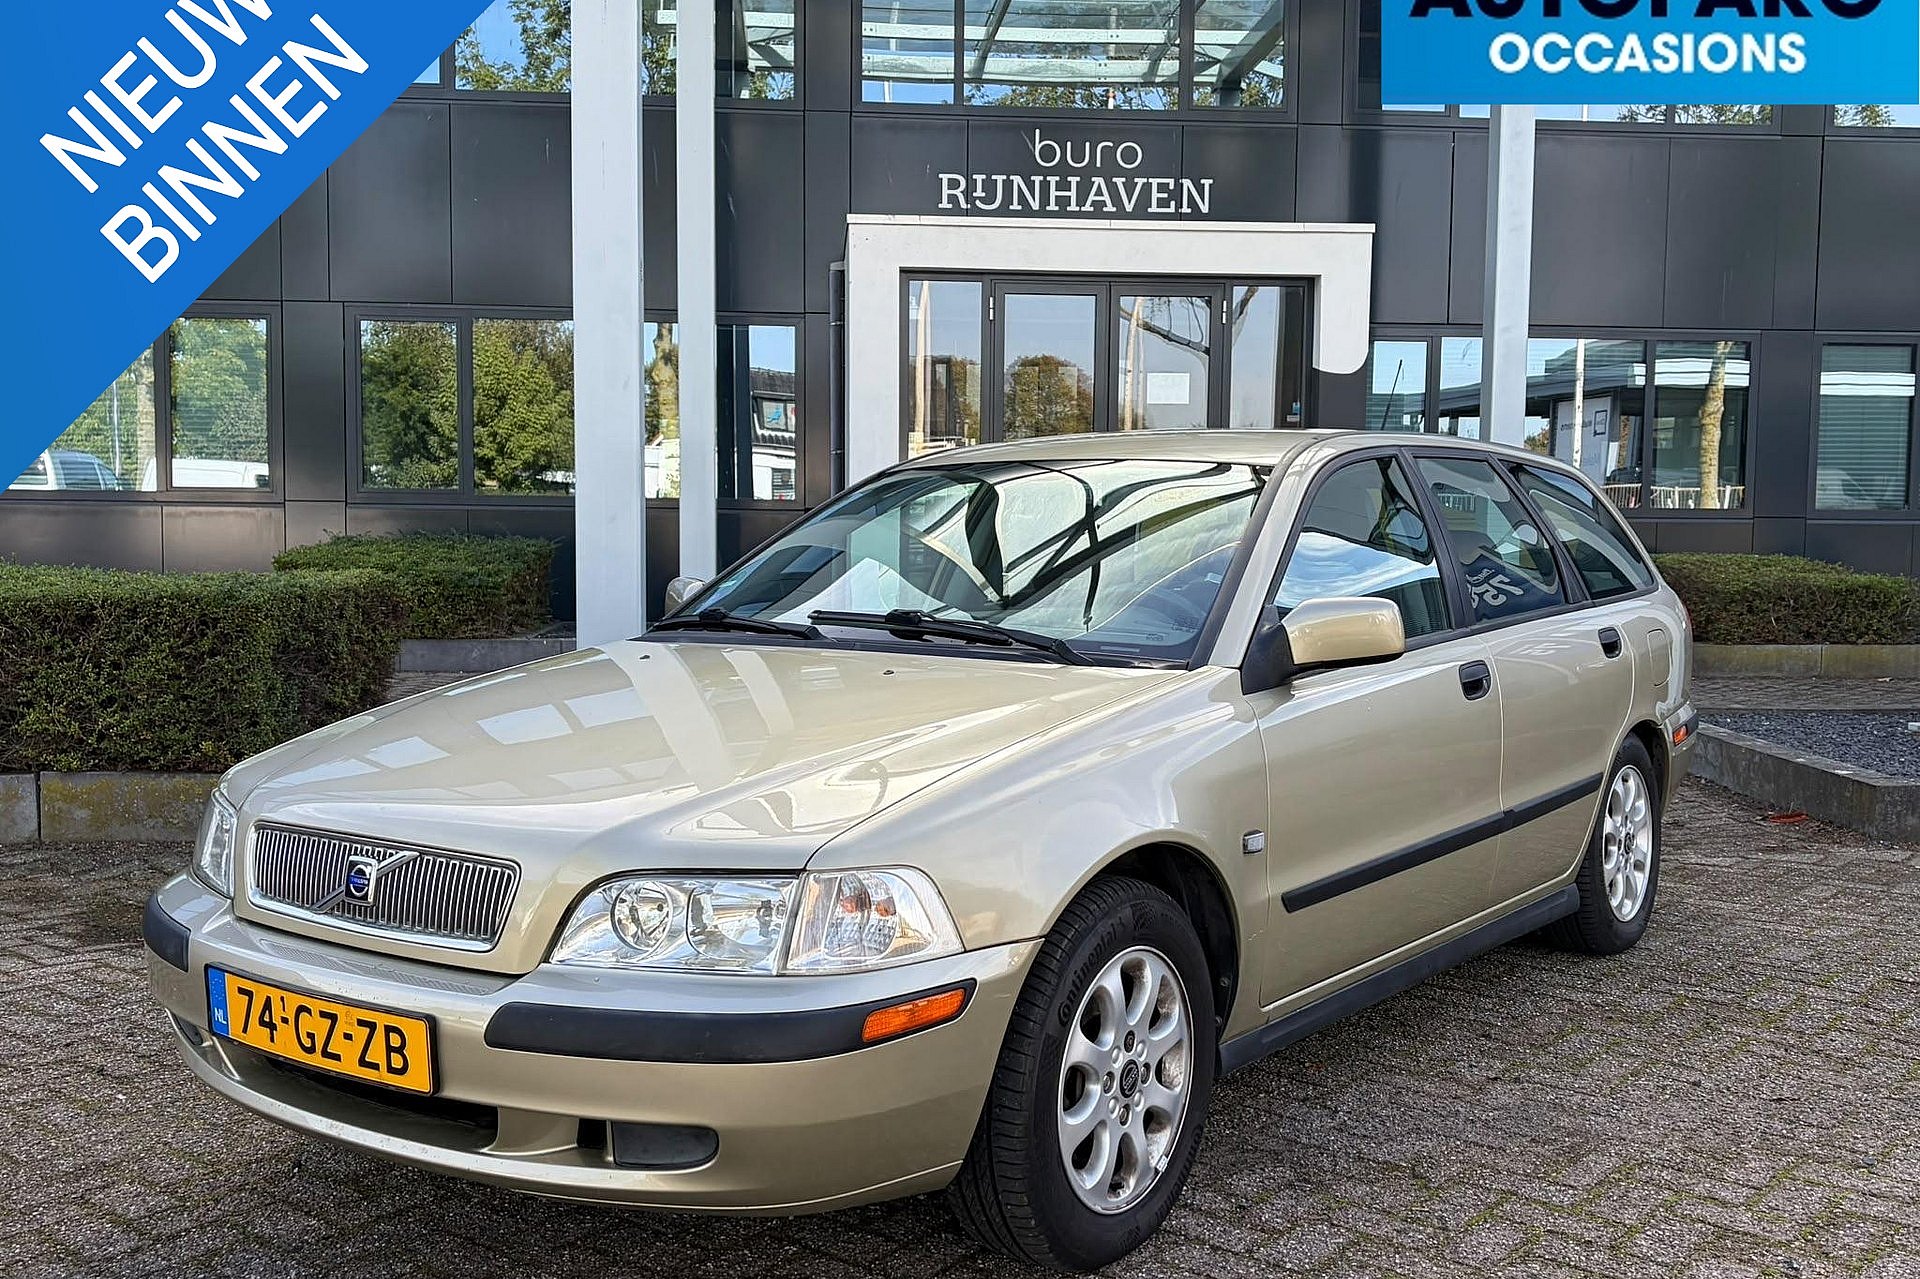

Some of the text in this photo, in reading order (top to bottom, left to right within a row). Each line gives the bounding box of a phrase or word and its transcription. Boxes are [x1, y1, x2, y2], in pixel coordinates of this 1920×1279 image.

[1034, 128, 1143, 169] buro
[938, 173, 1214, 214] RIJNHAVEN
[214, 986, 410, 1076] NL 74-GZ-ZB
